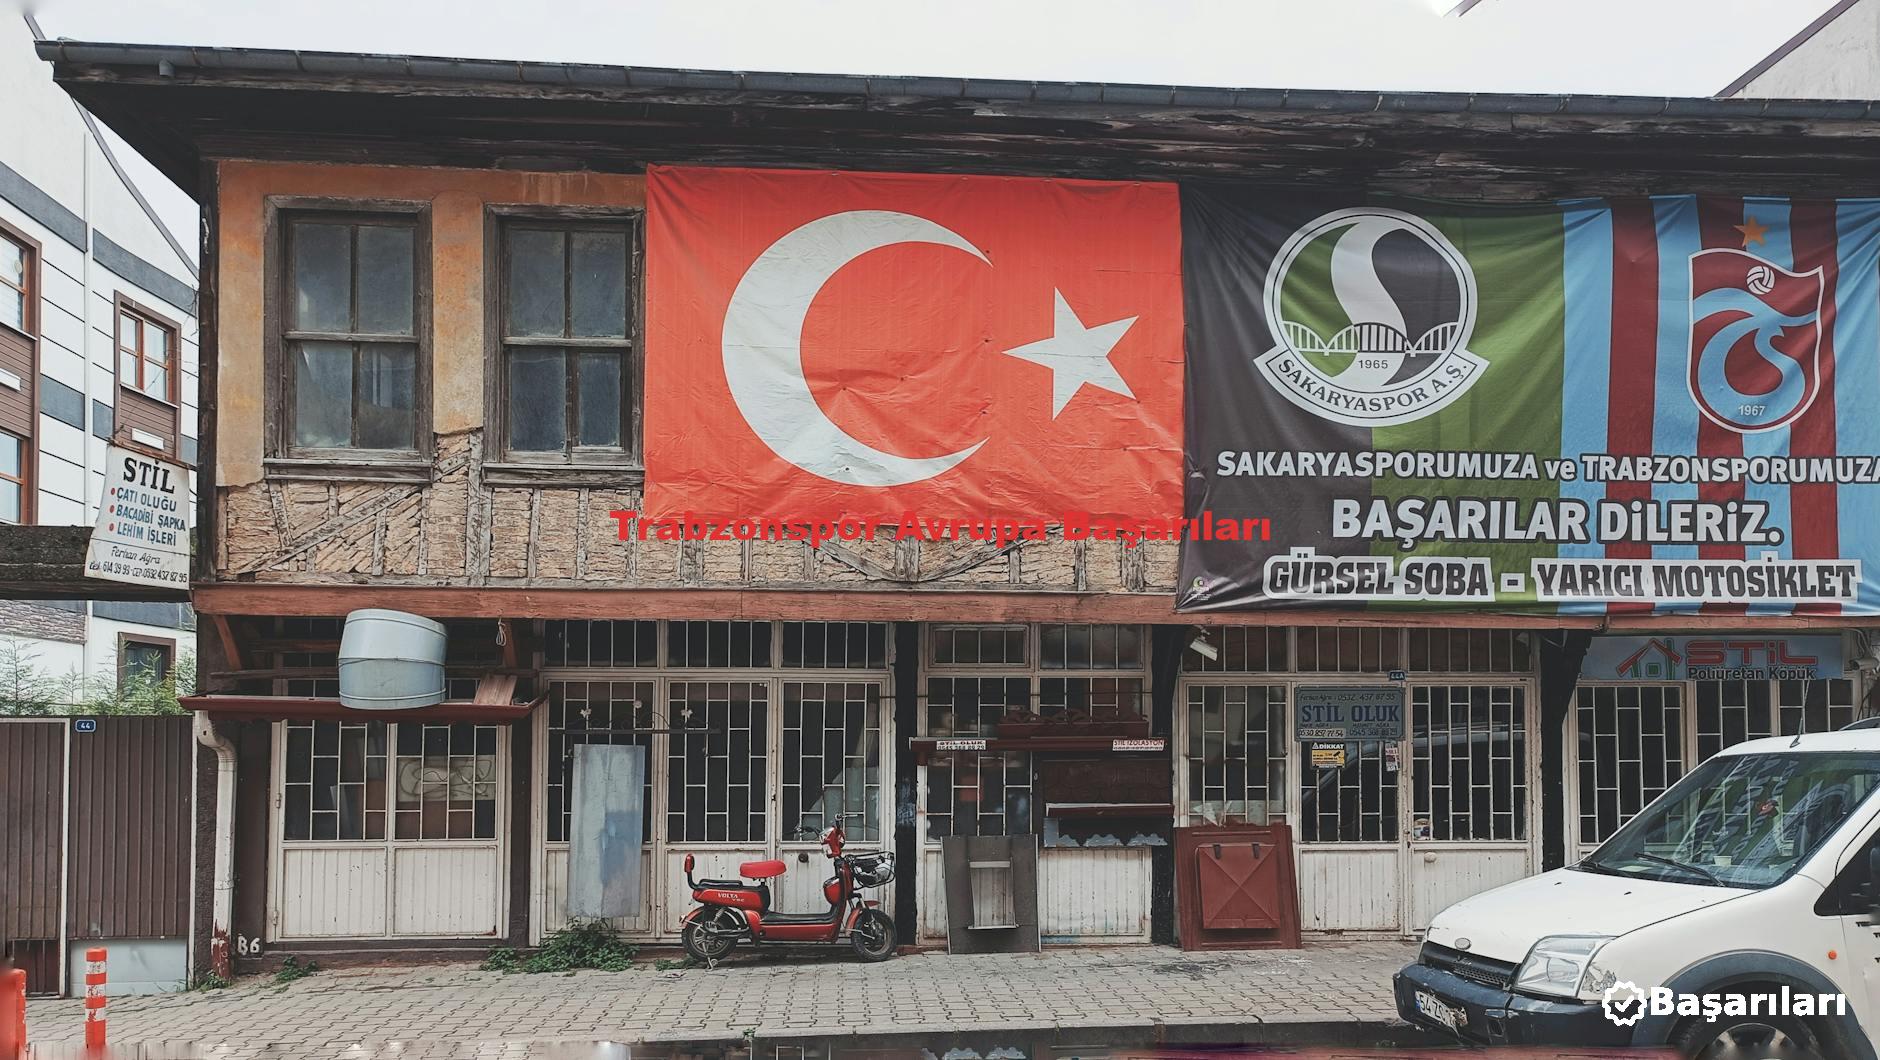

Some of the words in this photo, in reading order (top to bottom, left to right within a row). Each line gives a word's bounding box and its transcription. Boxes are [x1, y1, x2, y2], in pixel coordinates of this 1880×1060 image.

[1357, 359, 1389, 370] 1965
[1278, 358, 1429, 413] SAKARYASPOR
[1431, 363, 1468, 389] A.Ş.
[1738, 405, 1766, 416] 1967
[123, 457, 175, 494] STİL
[1217, 451, 1538, 479] SAKARYASPORUMUZA
[1545, 459, 1576, 480] ve
[1582, 456, 1880, 482] TRABZONSPORUMUZA
[116, 487, 138, 503] ÇATI
[141, 495, 177, 512] OLUĞU
[116, 504, 154, 524] BACADİBİ
[157, 514, 186, 531] ŞAPKA
[1332, 499, 1587, 548] BAŞARILAR
[117, 521, 144, 540] LEHİM
[147, 527, 177, 546] İŞLERİ
[1267, 549, 1394, 597] GÜRSEL
[1404, 560, 1491, 598] SOBA
[1536, 563, 1645, 598] YARICI
[1652, 555, 1857, 599] MOTOSİKLET
[1688, 666, 1765, 680] Poliüretan
[1769, 665, 1816, 680] Köpük
[1301, 702, 1345, 722] STİL
[1351, 705, 1399, 722] OLUK
[238, 936, 260, 955] B6
